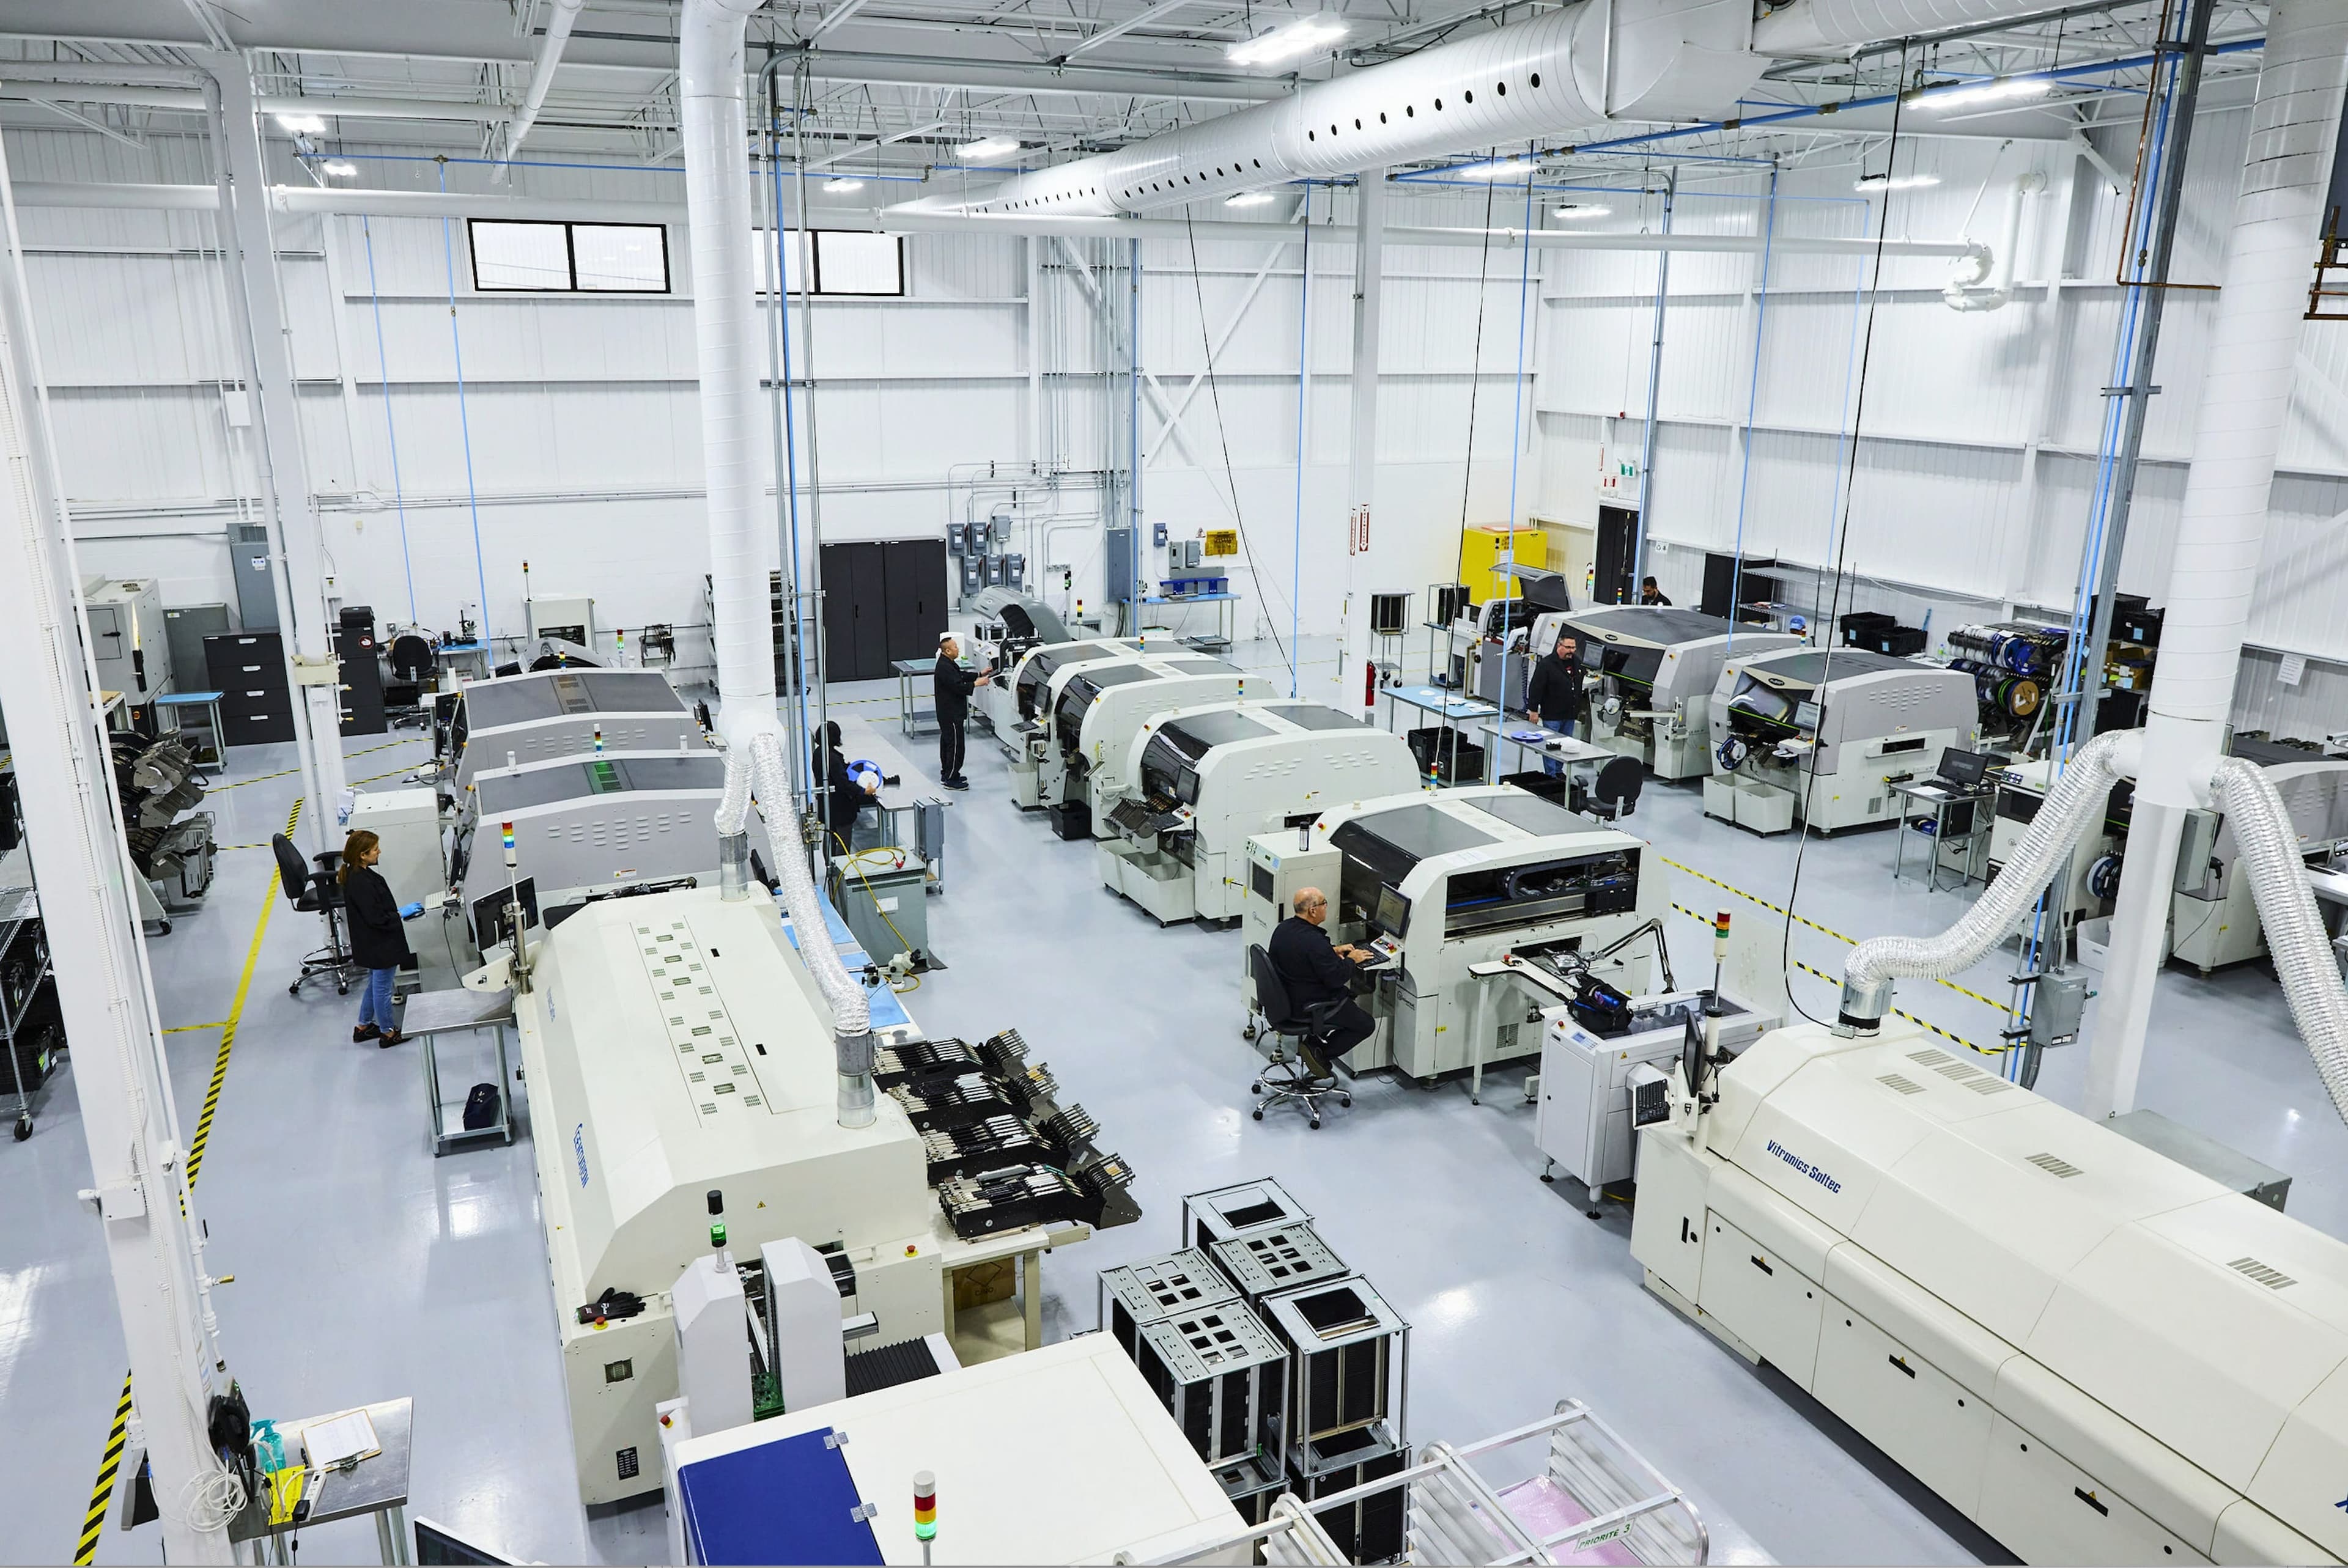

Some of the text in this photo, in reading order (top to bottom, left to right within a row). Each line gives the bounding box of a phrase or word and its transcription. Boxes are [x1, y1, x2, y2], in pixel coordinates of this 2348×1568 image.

[1767, 1139, 1841, 1194] Vitronics Soltec
[1578, 1523, 1630, 1549] PRIORITÉ 3
